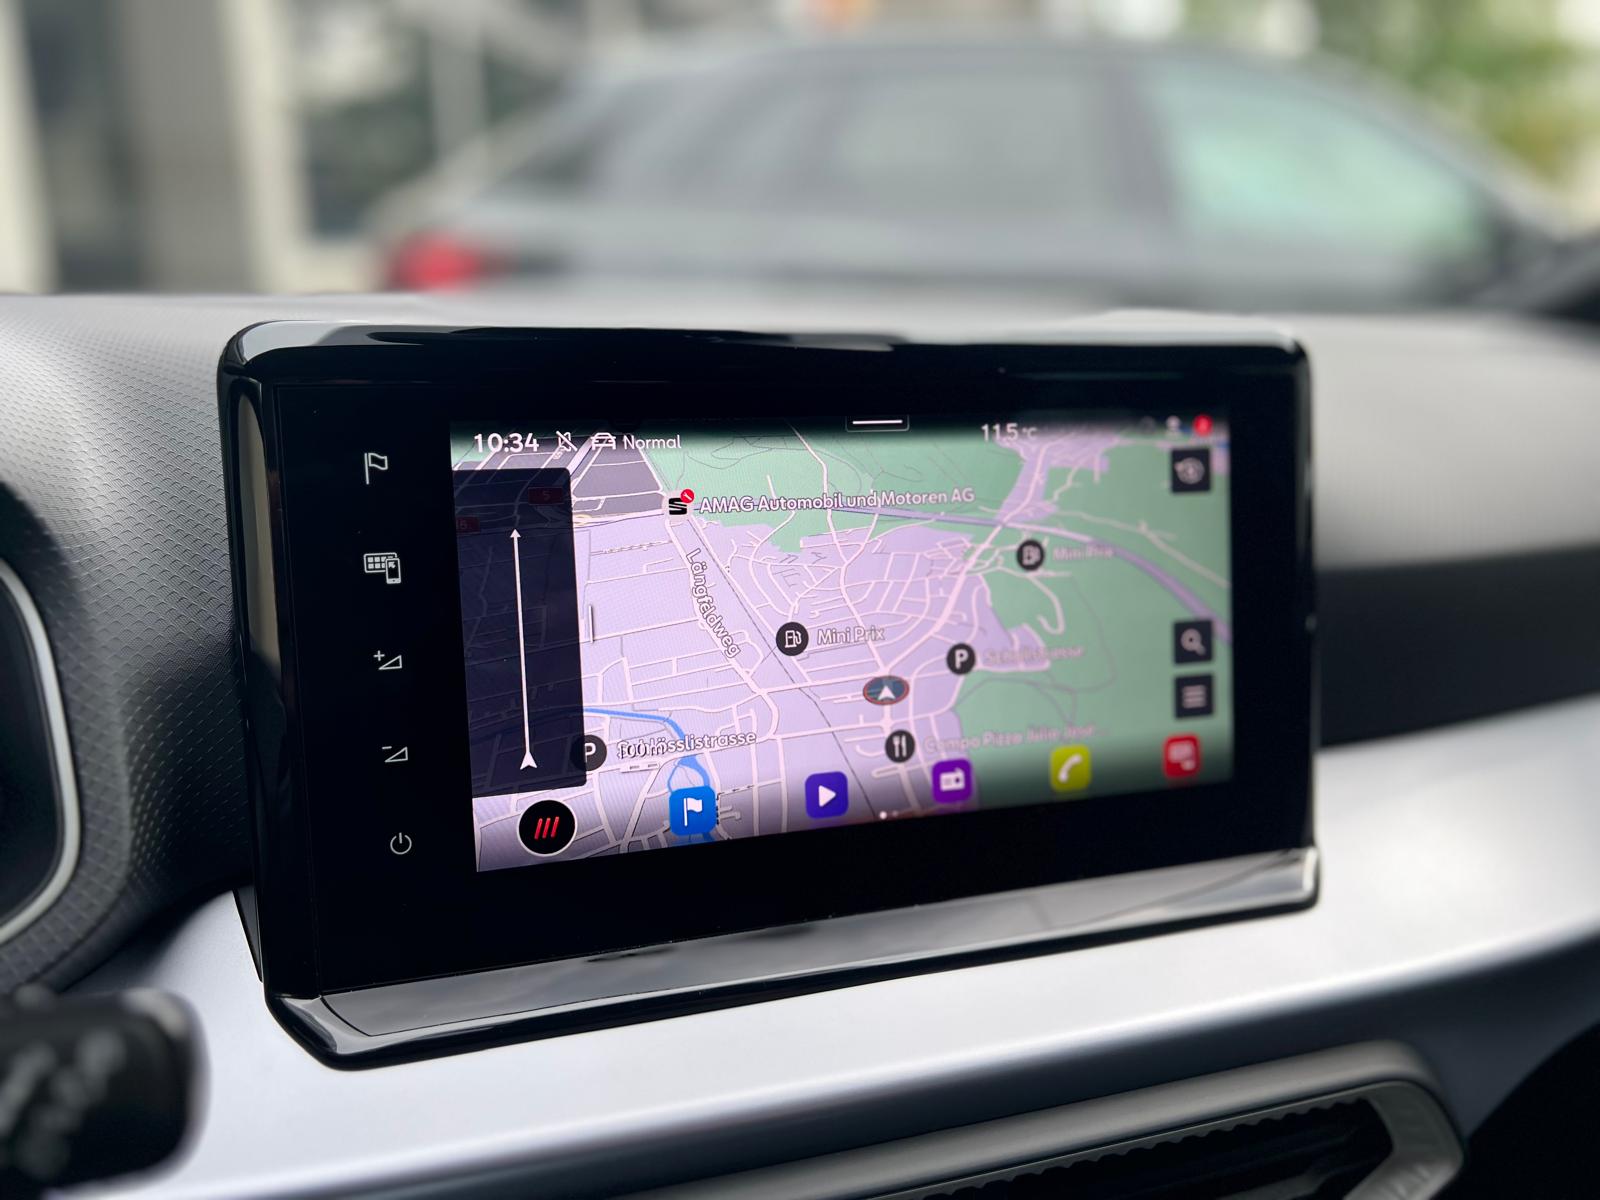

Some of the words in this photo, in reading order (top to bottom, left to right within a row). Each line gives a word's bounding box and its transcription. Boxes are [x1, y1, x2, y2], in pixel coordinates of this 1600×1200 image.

[474, 432, 539, 453] 10:34
[623, 434, 682, 450] Normal
[699, 497, 754, 513] AMAG
[758, 492, 844, 511] Automobil
[846, 491, 877, 507] und
[881, 490, 947, 506] Motoren
[951, 487, 975, 502] AG
[685, 548, 741, 658] Längfeldweg
[817, 628, 851, 645] Mini
[853, 625, 884, 642] Prix
[955, 650, 968, 669] P
